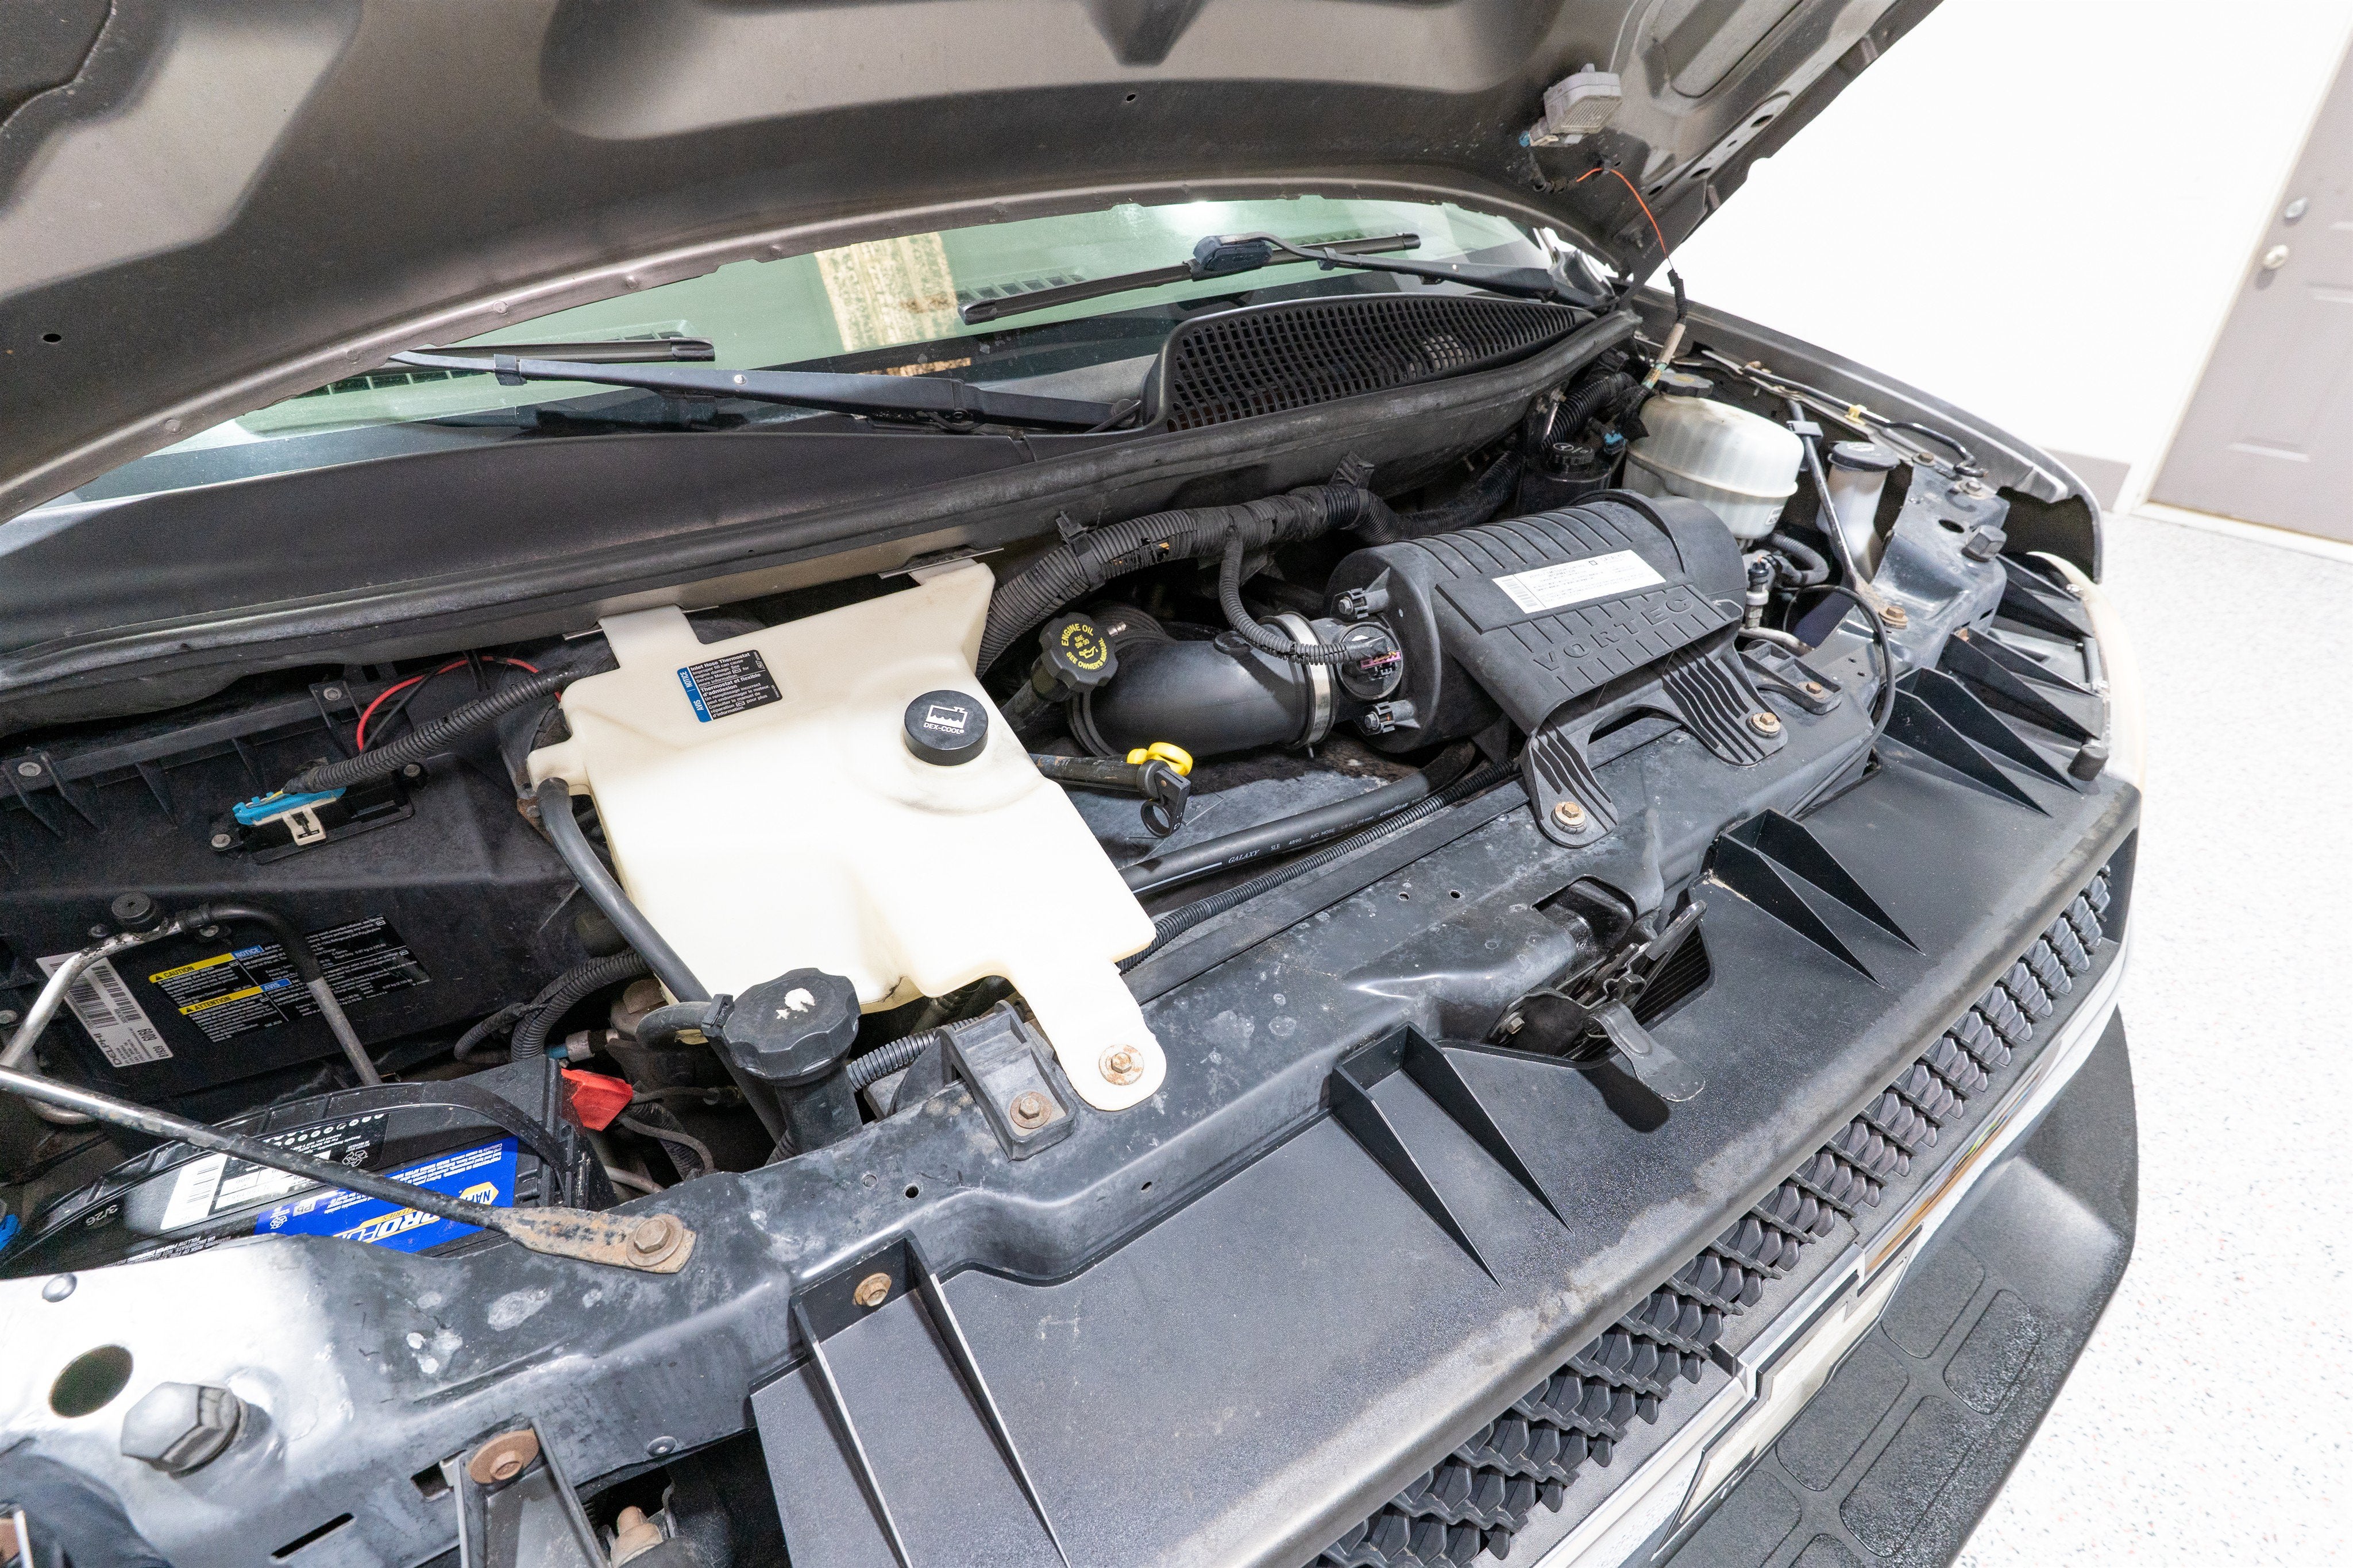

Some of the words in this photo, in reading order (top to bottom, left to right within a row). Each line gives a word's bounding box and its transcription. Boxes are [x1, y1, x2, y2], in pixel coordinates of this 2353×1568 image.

[1061, 623, 1081, 647] ENGINE
[1082, 624, 1094, 636] OIL
[1533, 597, 1694, 670] VORTEC
[1066, 651, 1078, 664] SEE
[1098, 637, 1108, 663] MANUAL
[719, 652, 750, 663] Thermostat
[693, 667, 713, 675] Improper
[711, 667, 730, 675] damage.
[680, 671, 693, 688] NOTICE
[701, 681, 733, 693] Thermostat
[740, 673, 761, 681] flexible
[711, 674, 738, 683] information.
[703, 684, 738, 697] d'admission
[712, 689, 740, 700] remplissage
[741, 683, 761, 691] incorrect
[718, 691, 748, 702] endommager
[693, 701, 705, 712] AVIS
[709, 700, 731, 709] Consulter
[711, 704, 735, 714] réparation
[713, 705, 745, 718] d'information.
[1228, 849, 1260, 863] GALAXY
[1321, 828, 1335, 836] HOSE
[234, 948, 261, 957] NOTICE
[163, 966, 195, 978] CAUTION
[193, 997, 233, 1010] ATTENTION
[92, 1033, 122, 1065] DELPHI
[483, 1142, 502, 1152] California
[297, 1204, 312, 1212] Pb
[86, 1204, 118, 1226] 3/26
[178, 1236, 200, 1246] FOLLOW
[205, 1235, 230, 1248] WARNING:
[156, 1243, 177, 1253] PROPER
